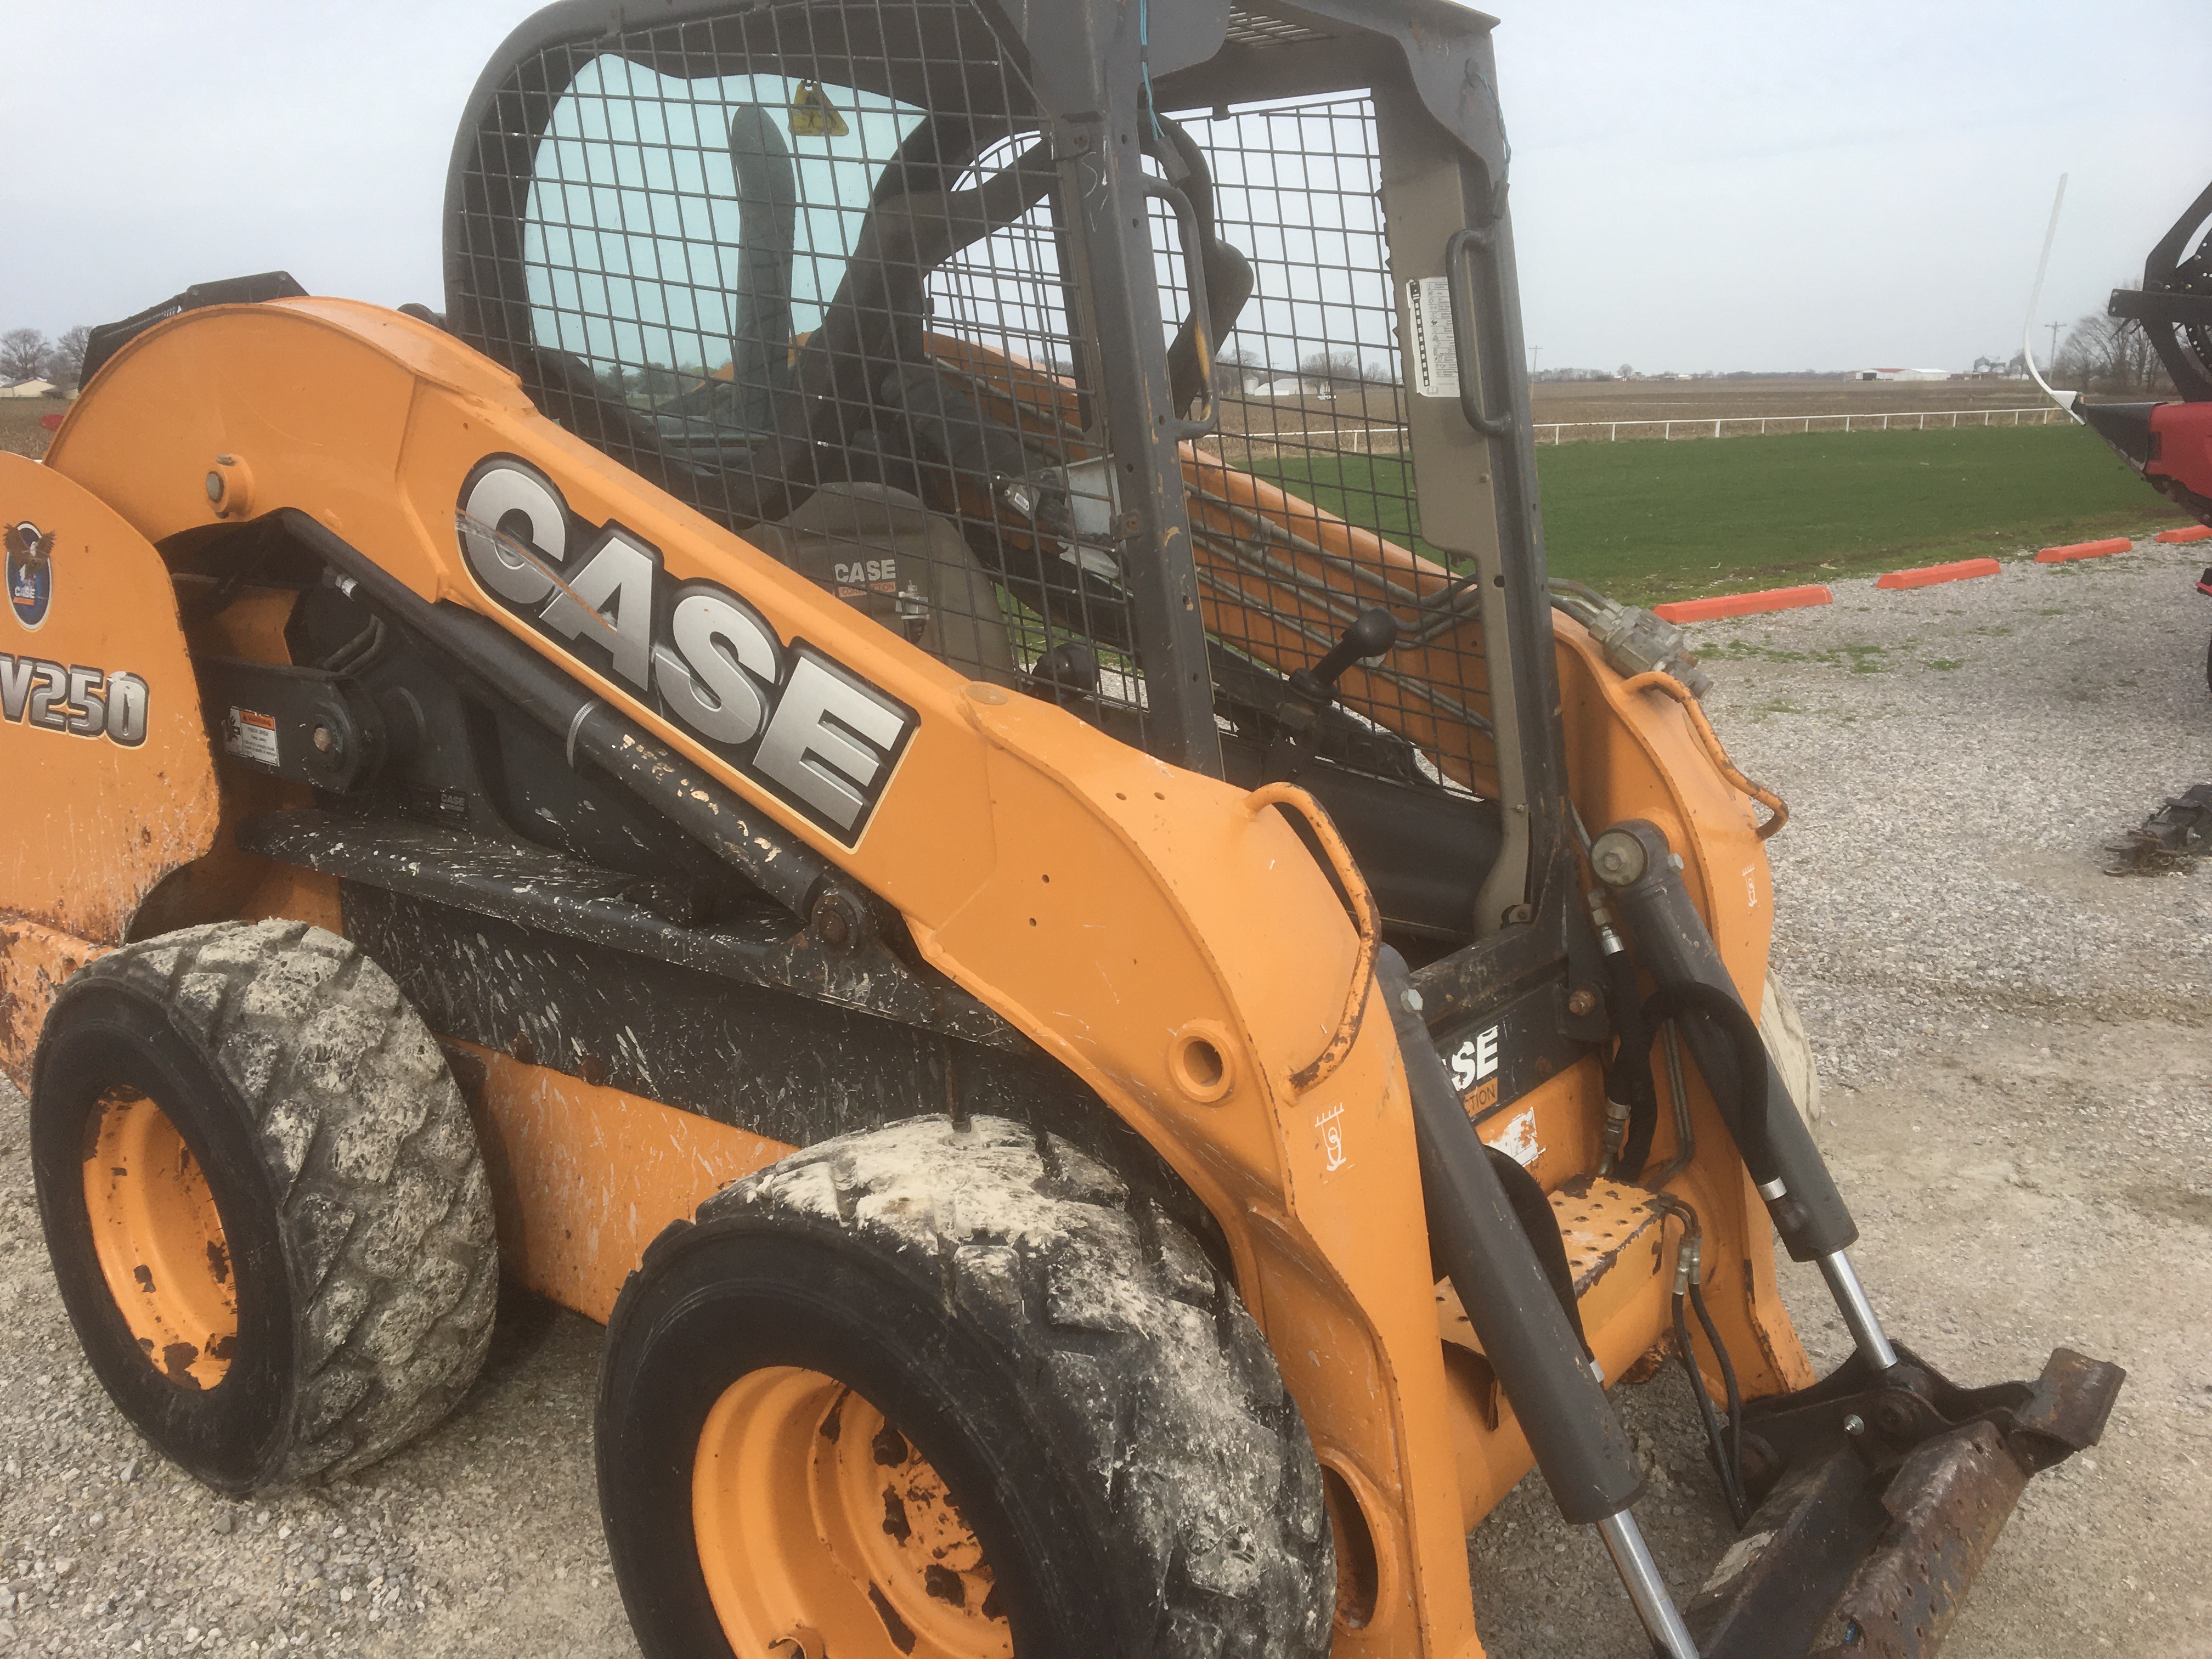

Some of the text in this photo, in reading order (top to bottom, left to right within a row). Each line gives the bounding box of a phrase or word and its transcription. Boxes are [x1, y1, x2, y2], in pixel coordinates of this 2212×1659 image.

[834, 559, 896, 583] CASE
[15, 586, 36, 599] CASE
[464, 468, 905, 832] CASE
[441, 793, 465, 806] CASE
